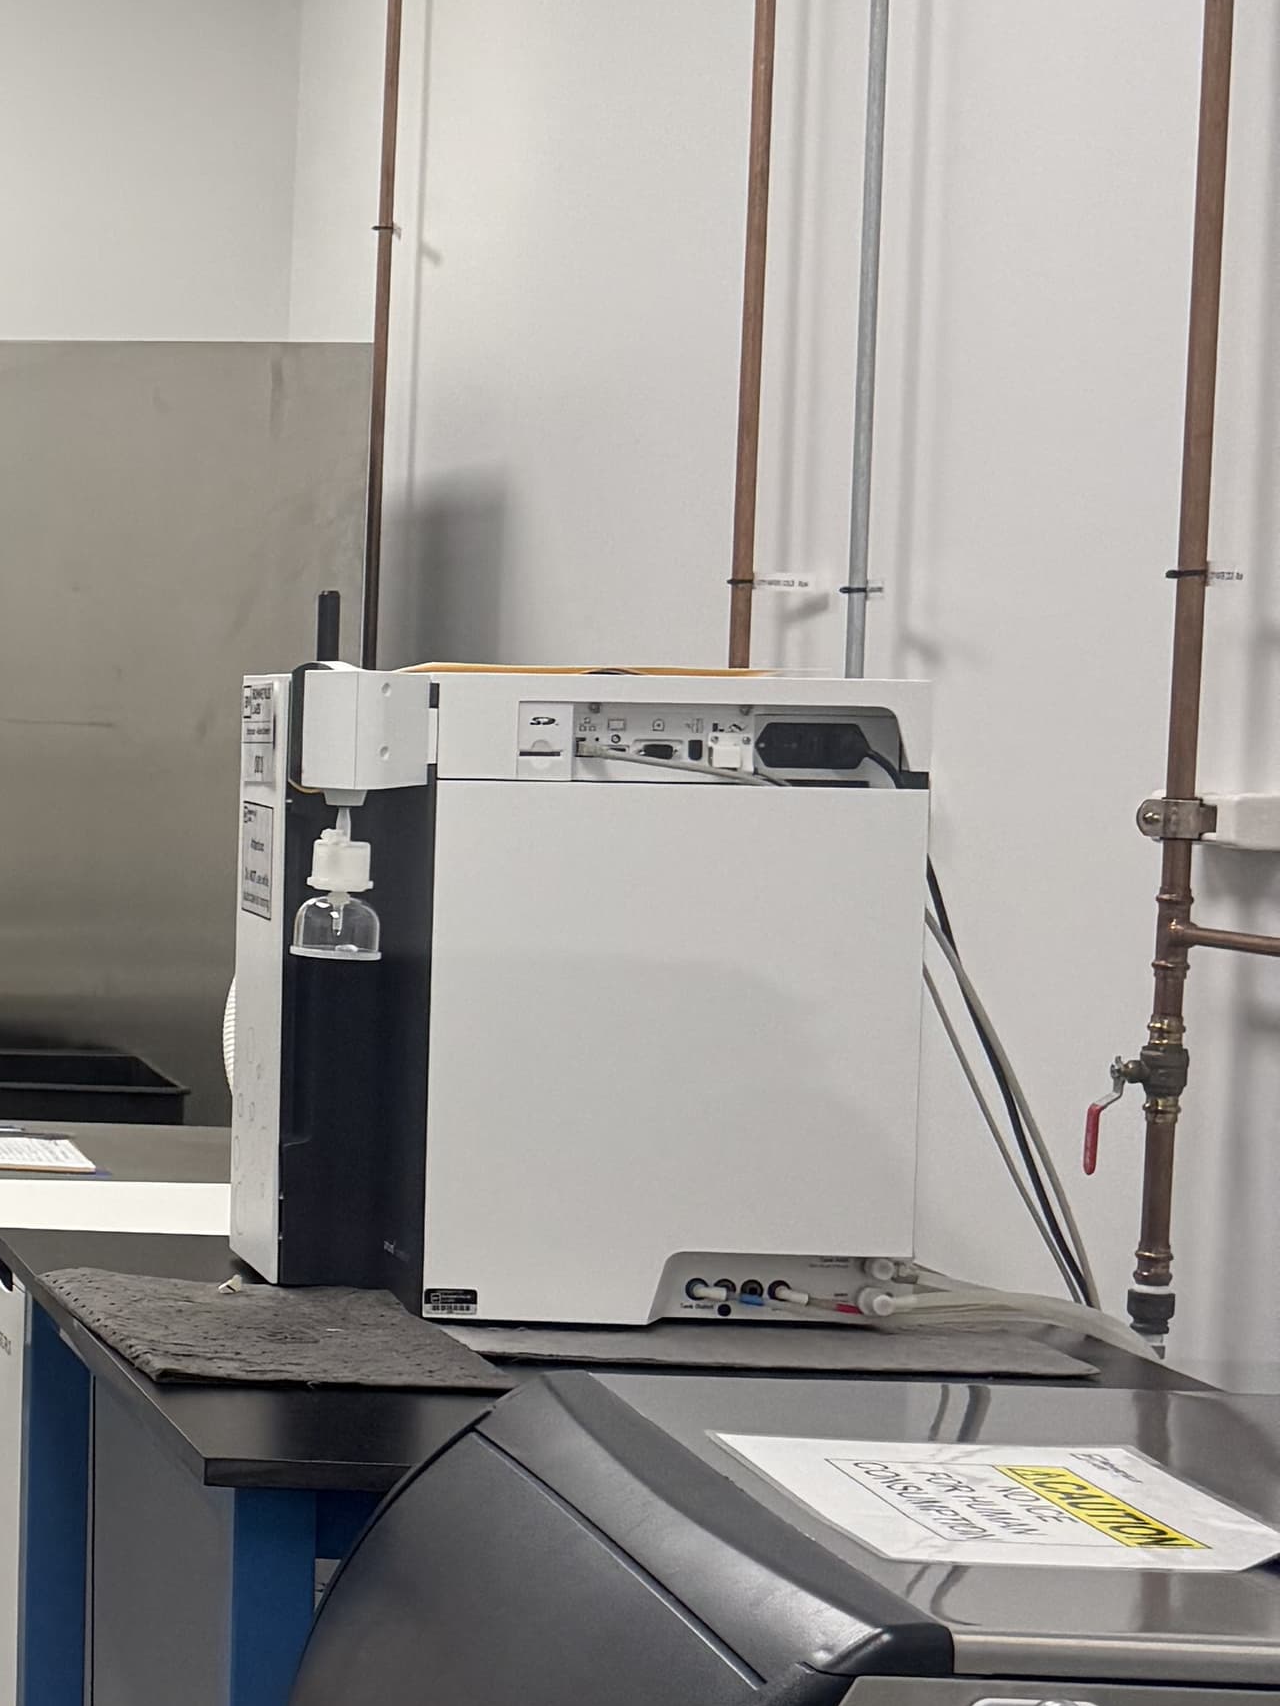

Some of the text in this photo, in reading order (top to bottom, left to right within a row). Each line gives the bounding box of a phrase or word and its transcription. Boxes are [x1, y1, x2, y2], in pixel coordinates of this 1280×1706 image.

[853, 1461, 995, 1540] CONSUMPTION
[914, 1471, 1048, 1536] FOR HUMAN
[1032, 1479, 1192, 1549] CAUTION
